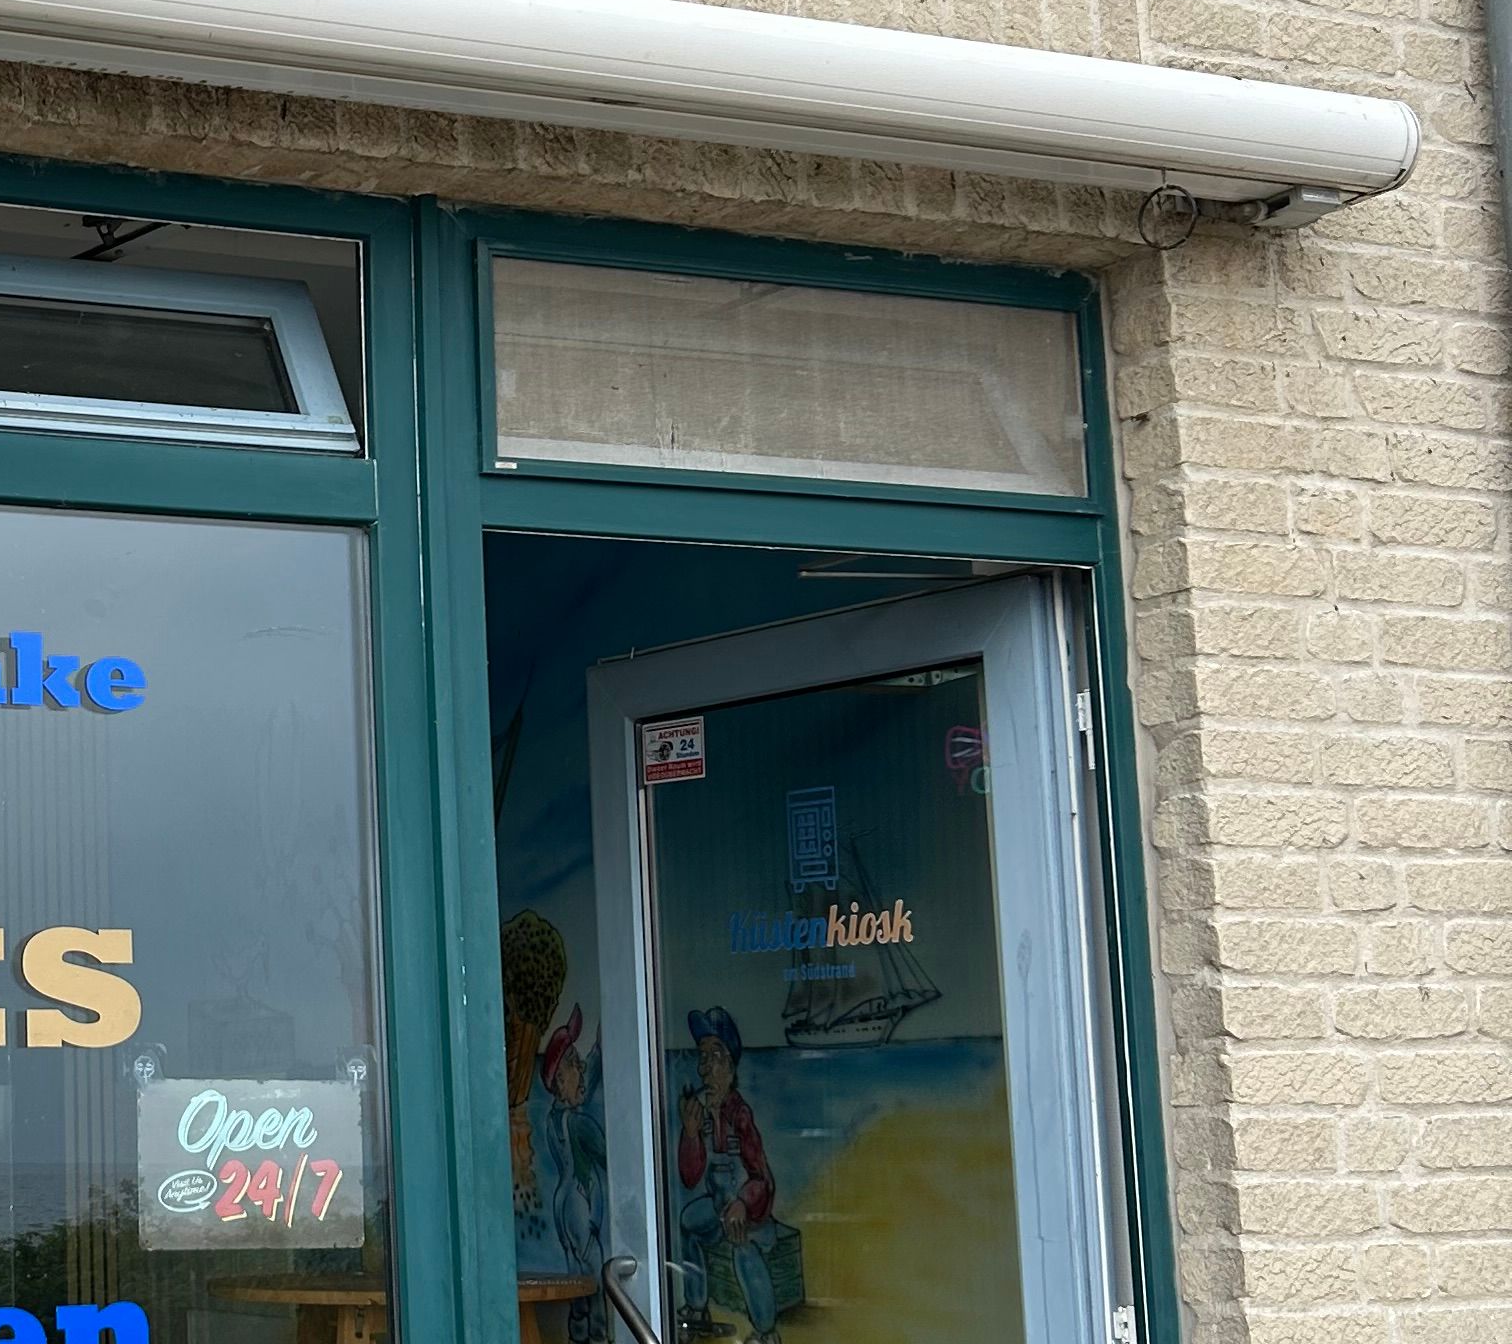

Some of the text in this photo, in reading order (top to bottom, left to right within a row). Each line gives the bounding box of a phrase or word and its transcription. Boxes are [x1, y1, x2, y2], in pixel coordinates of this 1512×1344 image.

[679, 738, 695, 751] 24
[177, 1089, 318, 1171] Open
[215, 1152, 344, 1229] 24/7
